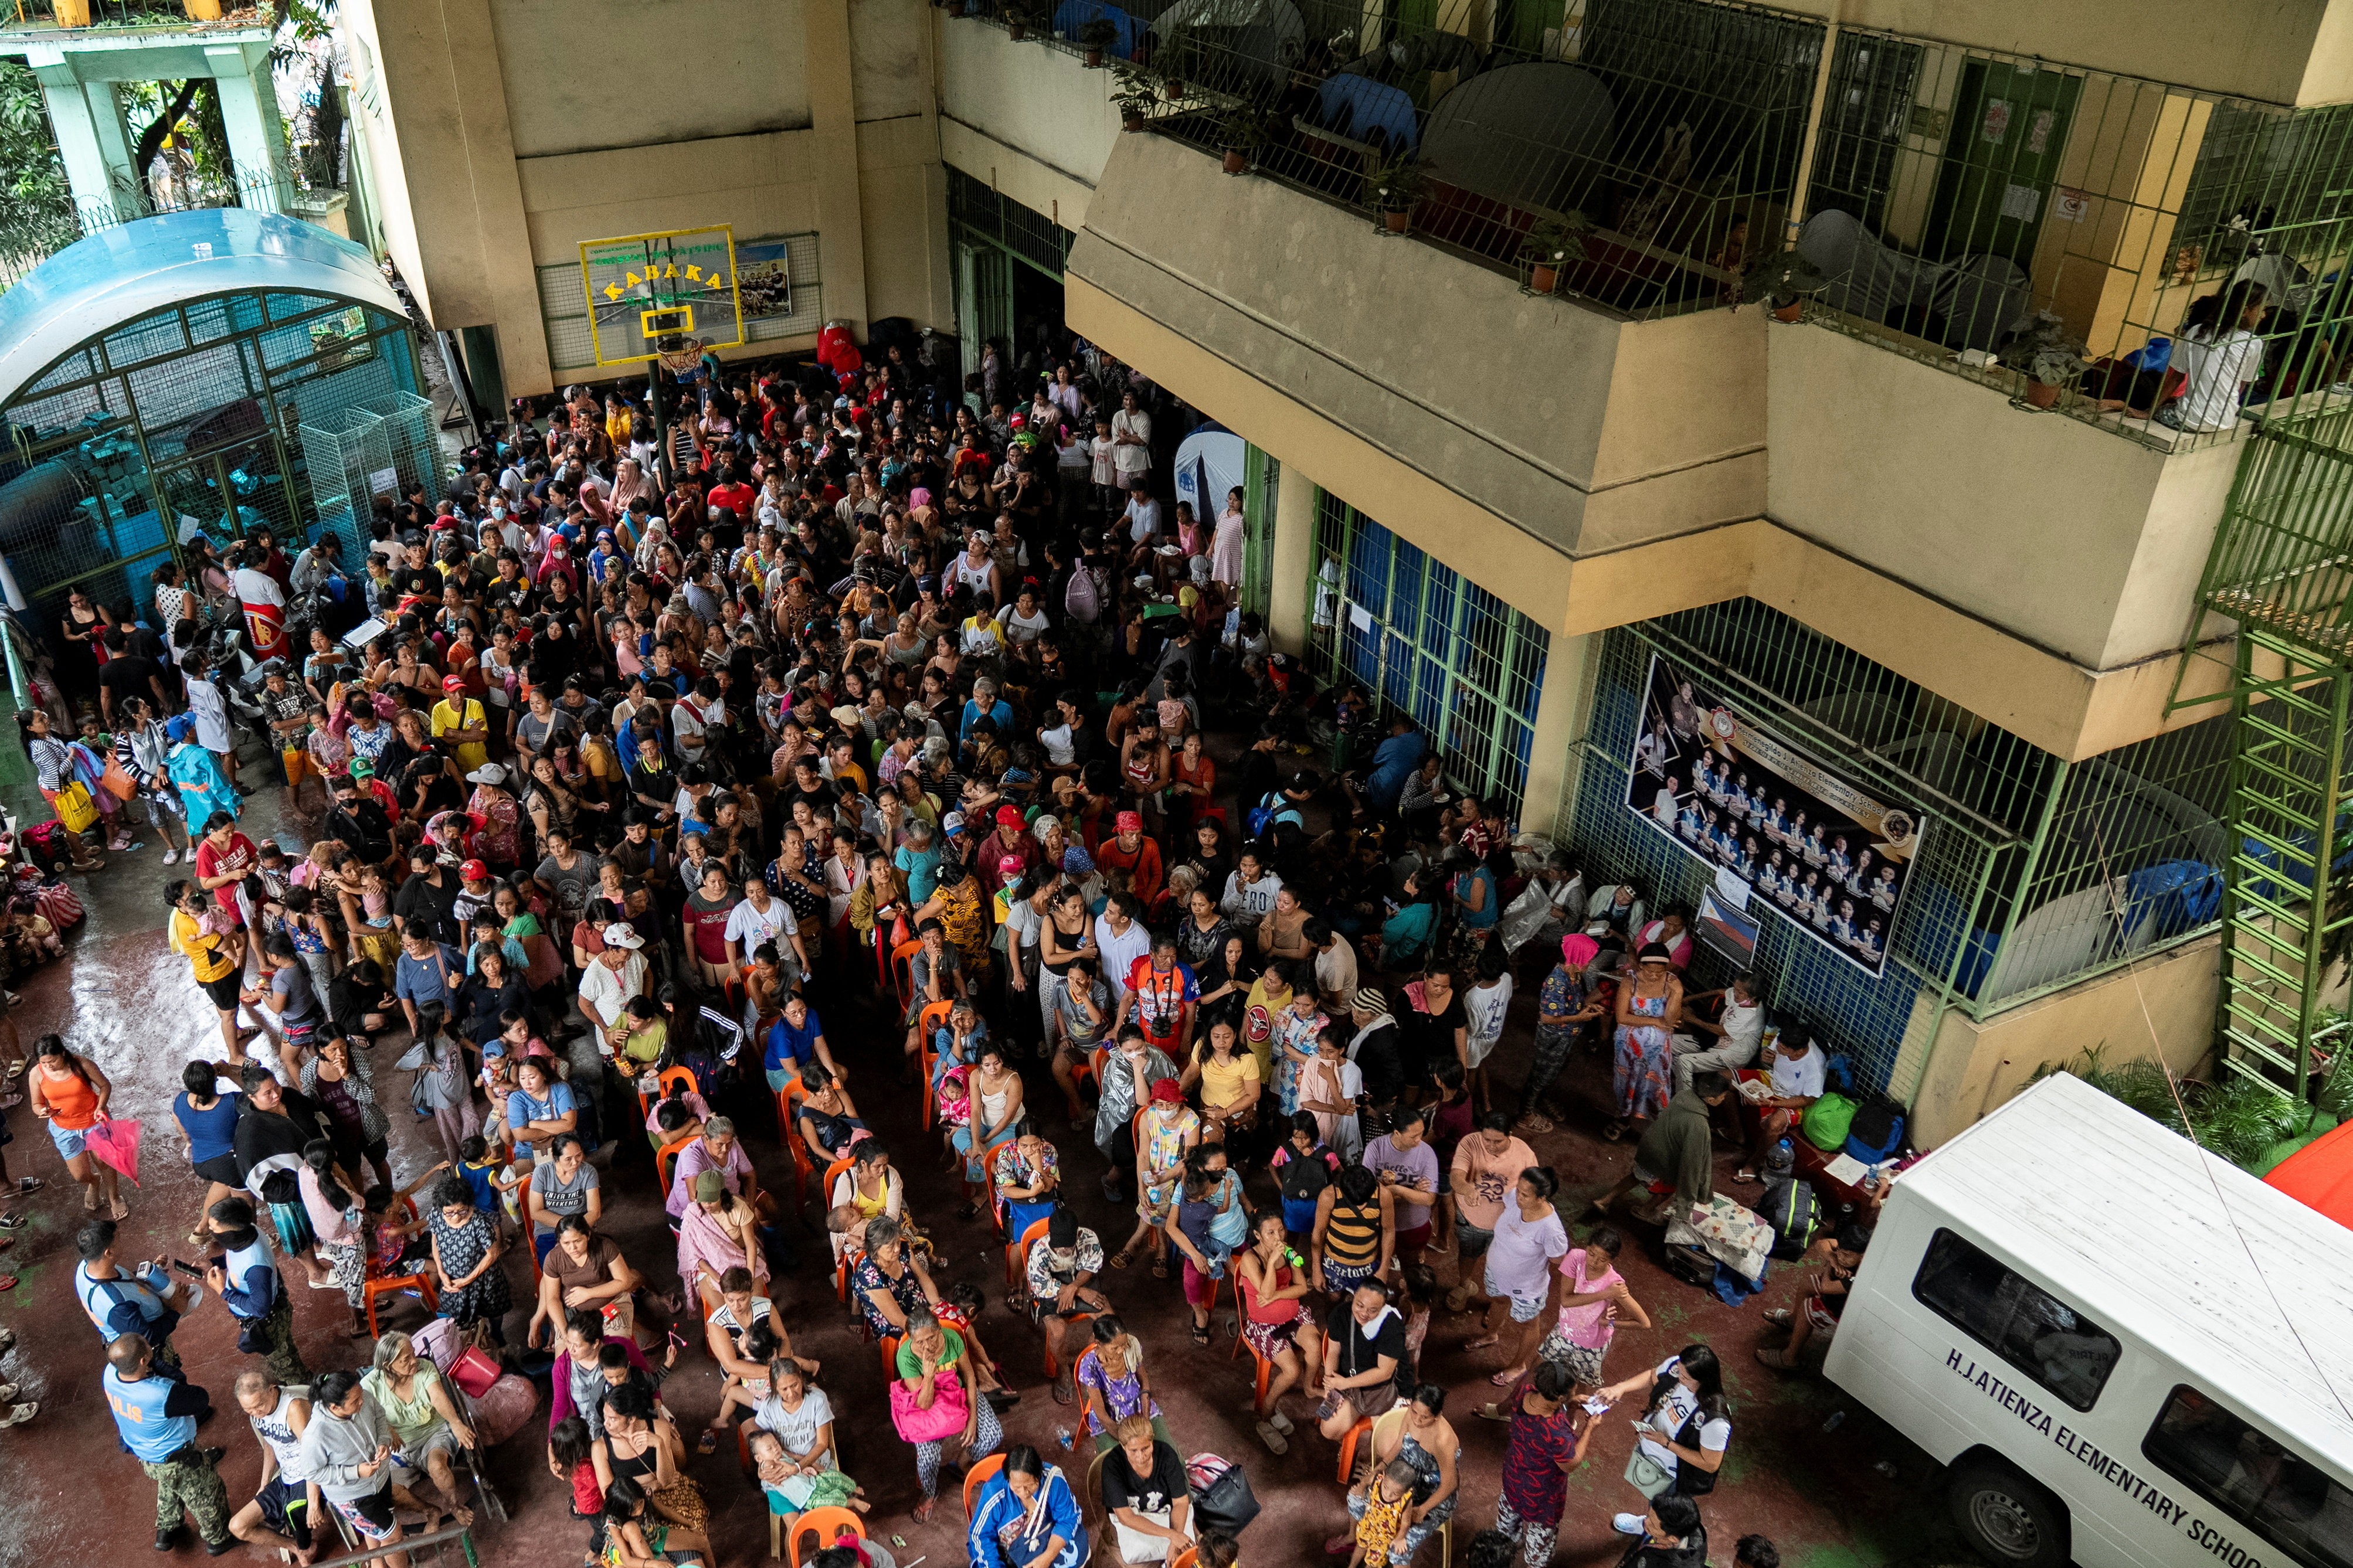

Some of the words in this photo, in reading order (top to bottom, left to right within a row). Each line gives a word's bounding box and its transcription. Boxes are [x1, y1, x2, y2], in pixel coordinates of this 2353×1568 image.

[604, 263, 721, 301] KABAKA
[1737, 723, 1781, 757] Hermenegildo
[1783, 753, 1788, 761] J.
[1791, 757, 1816, 777] Atienza
[1818, 772, 1858, 803] Elementary
[1859, 795, 1886, 818] School
[1240, 890, 1267, 911] ERO
[544, 1191, 565, 1200] ENTER
[568, 1191, 580, 1199] THE
[1945, 1348, 2053, 1437] H.J.ATIENZA
[2054, 1424, 2189, 1526] ELEMENTARY
[2187, 1519, 2269, 1568] SCHOO
